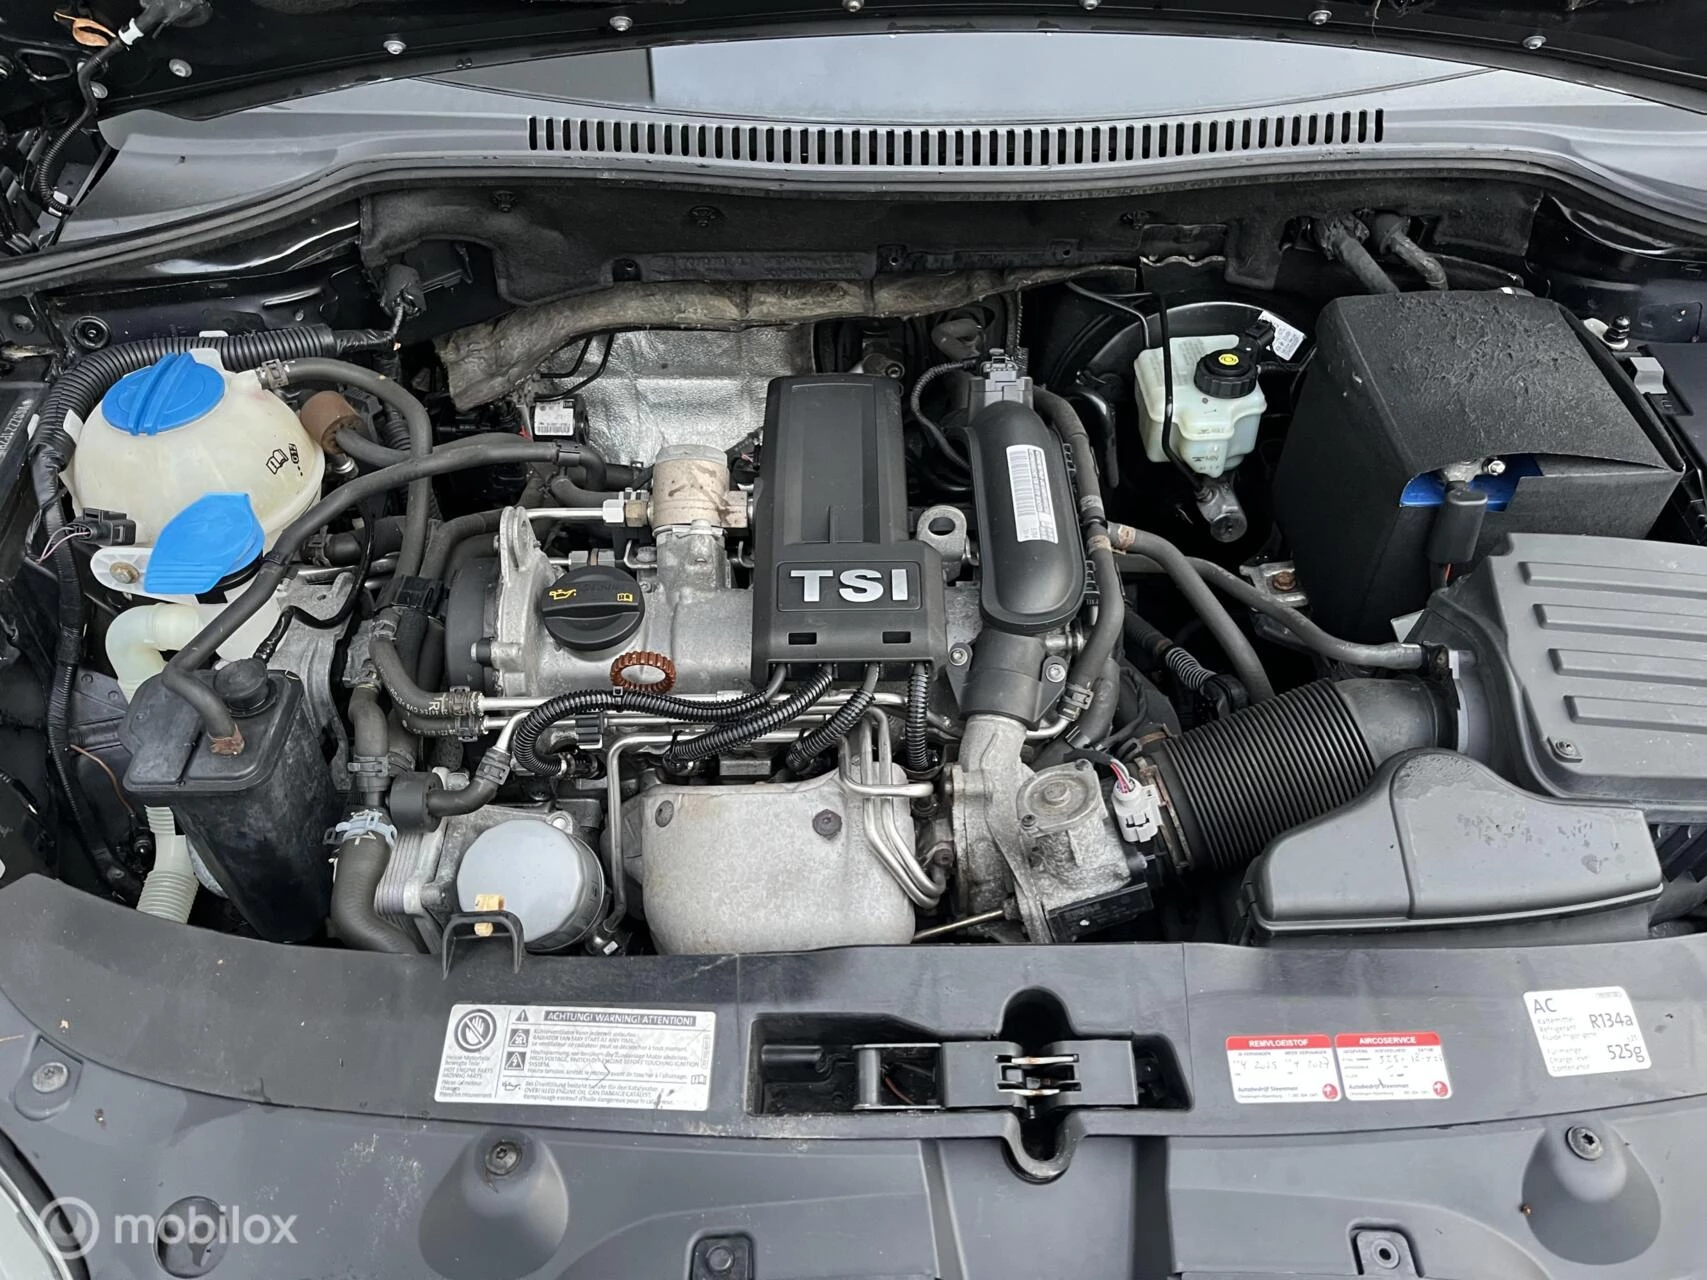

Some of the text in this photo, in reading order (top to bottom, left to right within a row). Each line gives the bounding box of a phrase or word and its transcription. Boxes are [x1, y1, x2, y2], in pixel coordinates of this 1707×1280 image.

[790, 568, 908, 602] TSI
[1534, 998, 1557, 1014] AC
[547, 1012, 693, 1025] ACHTUNG! WARNING! ATTENTION!
[1589, 1012, 1633, 1029] R134a
[1249, 1038, 1308, 1047] REMVLOEISTOF
[1360, 1036, 1416, 1045] AIRCOSERVICE
[1607, 1044, 1645, 1063] 525g
